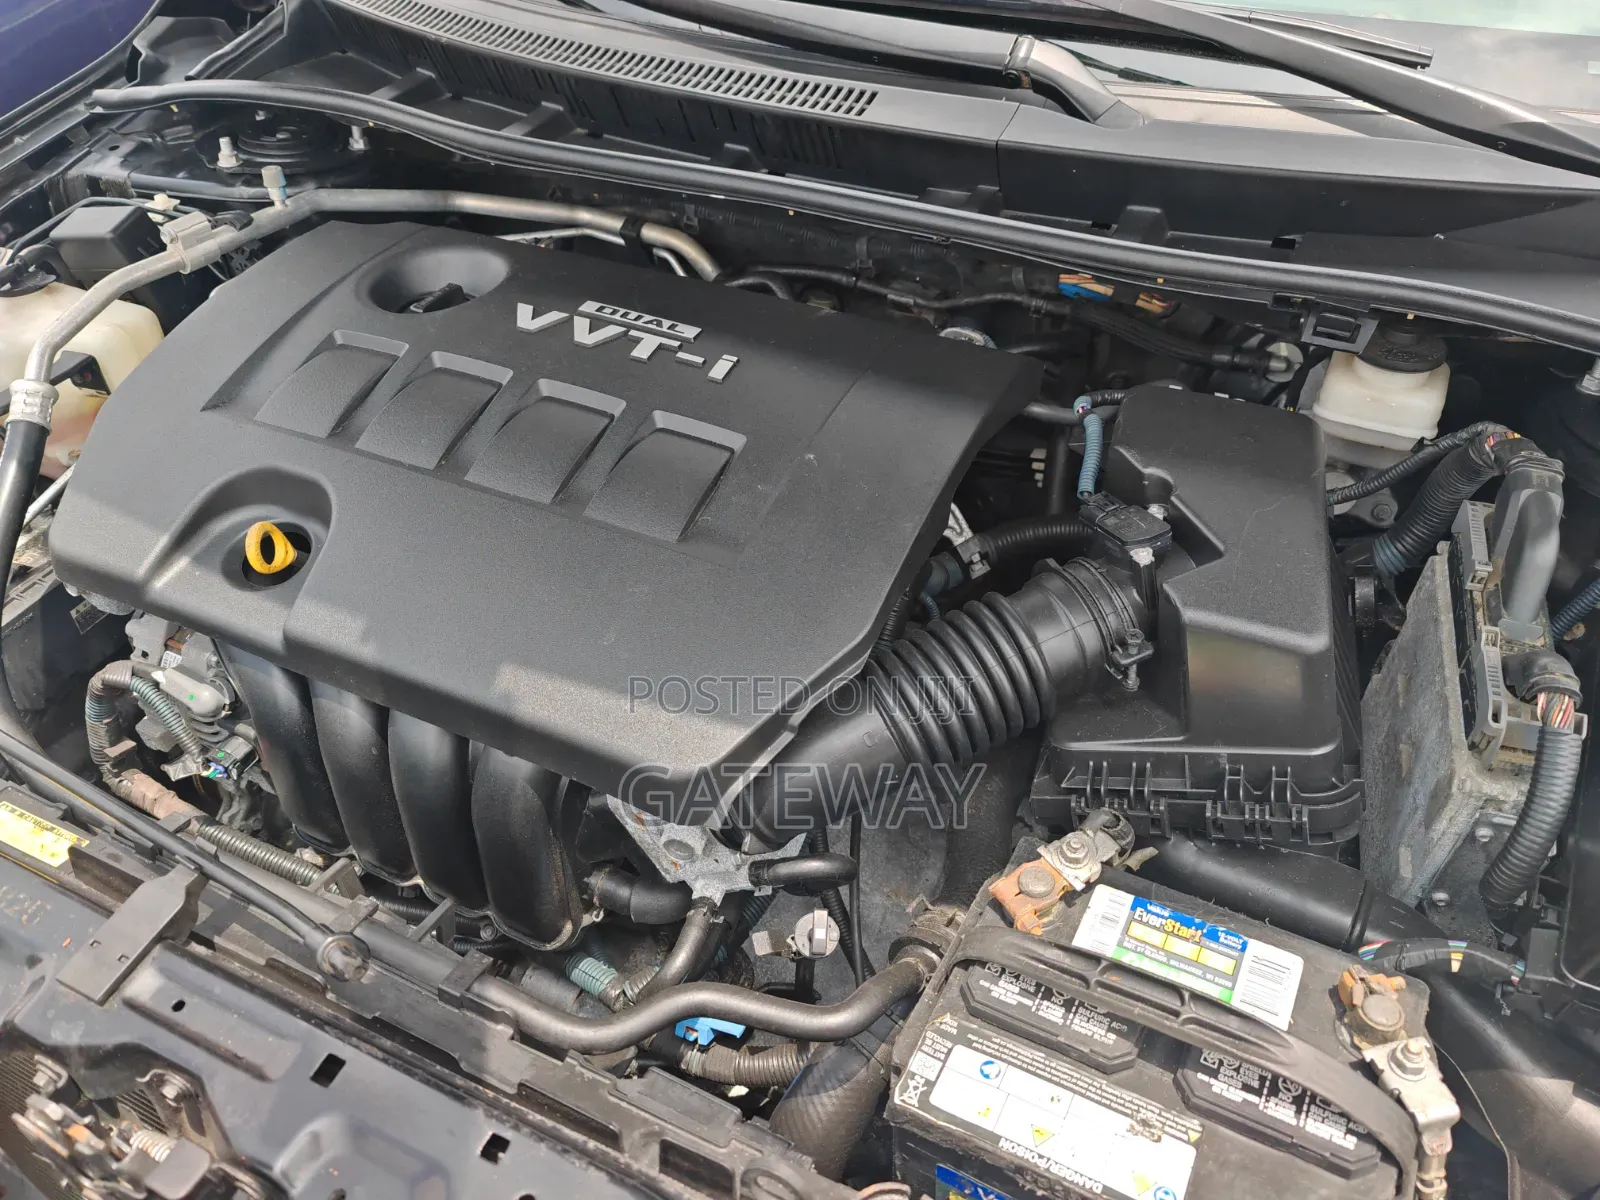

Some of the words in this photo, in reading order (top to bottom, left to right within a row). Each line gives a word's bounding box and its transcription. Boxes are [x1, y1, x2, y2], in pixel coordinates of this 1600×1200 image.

[594, 304, 686, 335] DUAL
[516, 302, 740, 383] VVT-i
[1132, 906, 1204, 943] EverStart
[1216, 930, 1243, 945] 12-VOLT
[1217, 936, 1241, 950] Battery
[997, 980, 1020, 993] GASES
[1000, 974, 1036, 992] EXPLOSIVE
[1018, 974, 1036, 986] EYES
[1050, 995, 1063, 1005] NO
[1076, 1006, 1111, 1025] SULFURIC
[939, 1022, 957, 1034] MADE
[923, 1037, 933, 1046] BE
[924, 1030, 953, 1048] RECYCLED
[919, 1042, 946, 1059] BATTERY
[931, 1041, 948, 1053] MUST
[1217, 1073, 1243, 1088] GASES
[1219, 1066, 1260, 1088] EXPLOSIVE
[1238, 1067, 1259, 1080] EYES
[1277, 1091, 1293, 1103] NO
[1309, 1104, 1348, 1125] SULFURIC
[1347, 1120, 1368, 1134] ACID
[996, 1136, 1105, 1194] DANGER/POISON
